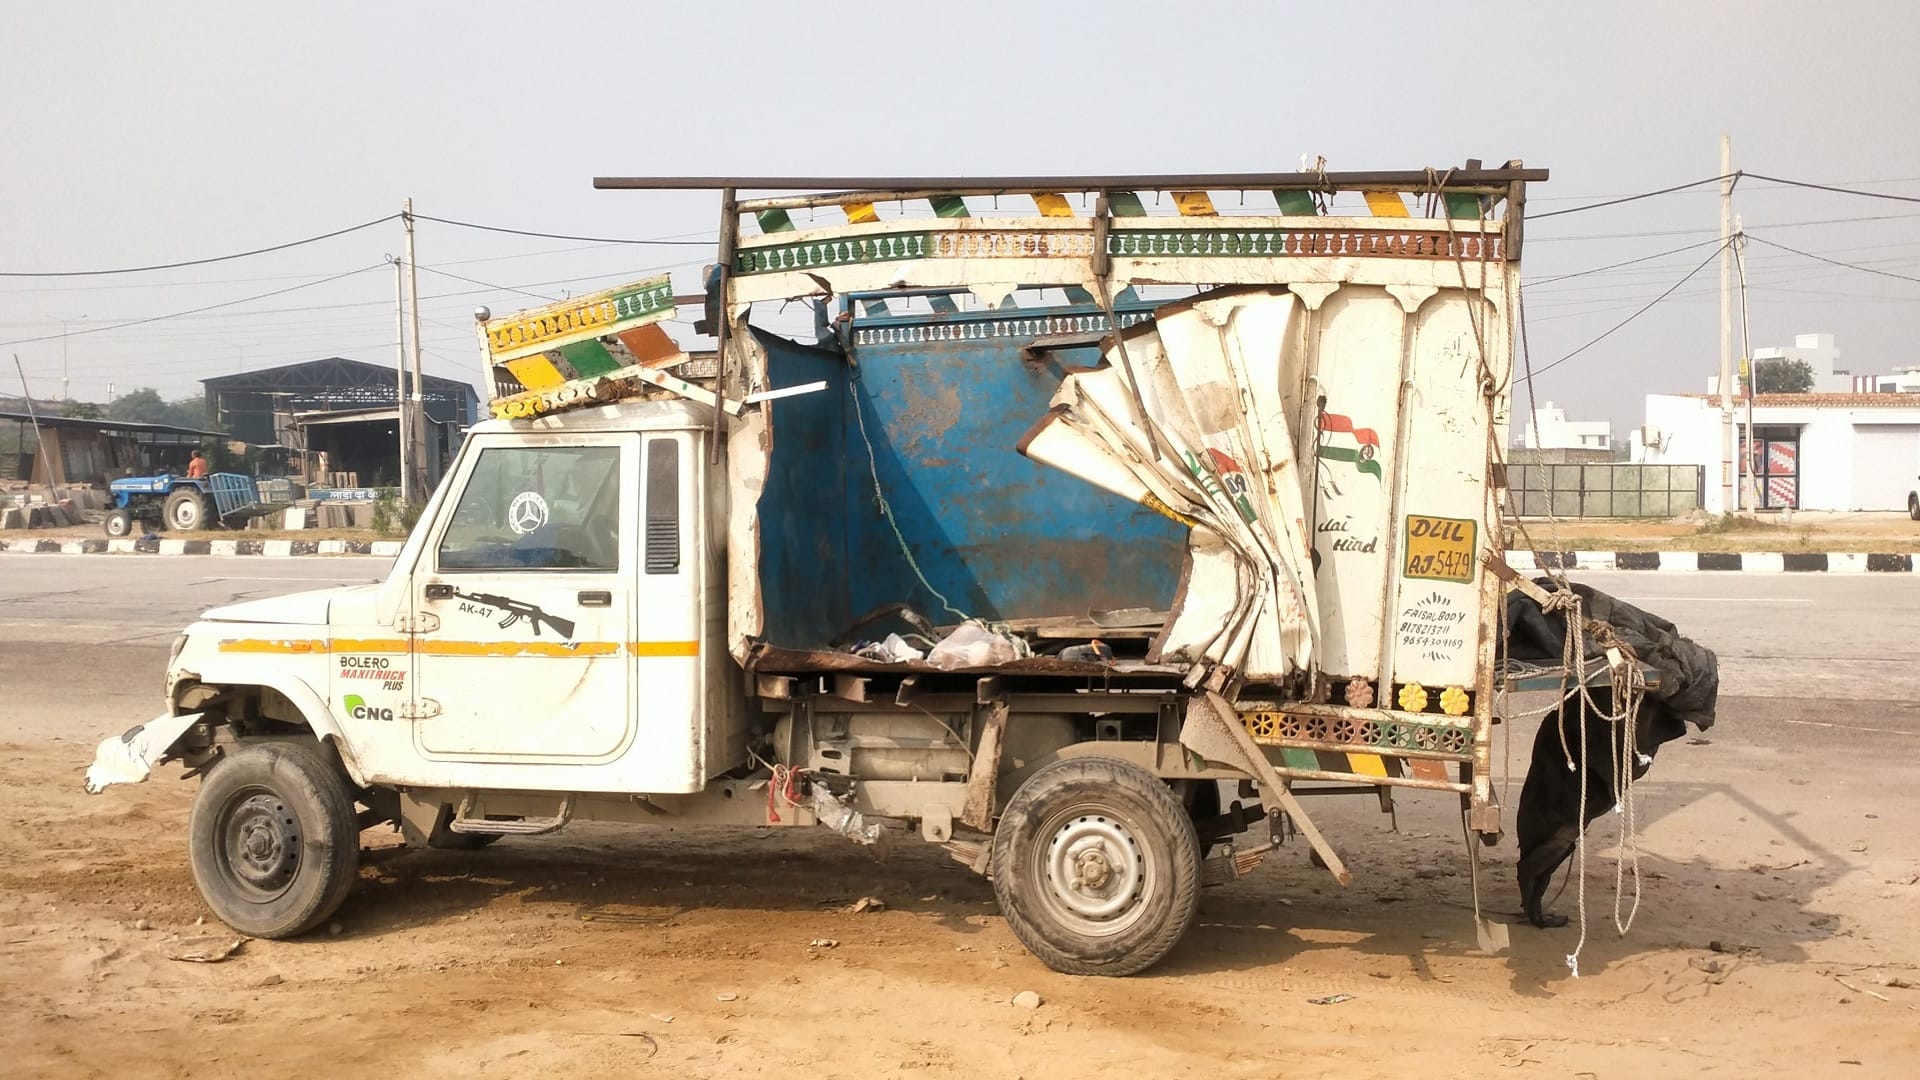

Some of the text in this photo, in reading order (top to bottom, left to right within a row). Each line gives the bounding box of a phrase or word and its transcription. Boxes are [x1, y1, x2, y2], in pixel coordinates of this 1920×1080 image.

[458, 602, 493, 618] AK-47
[1437, 611, 1466, 624] BODY
[340, 656, 389, 669] BOLERO
[340, 669, 407, 681] MAXITRUCK
[382, 681, 404, 691] PLUS
[353, 706, 394, 722] CNG
